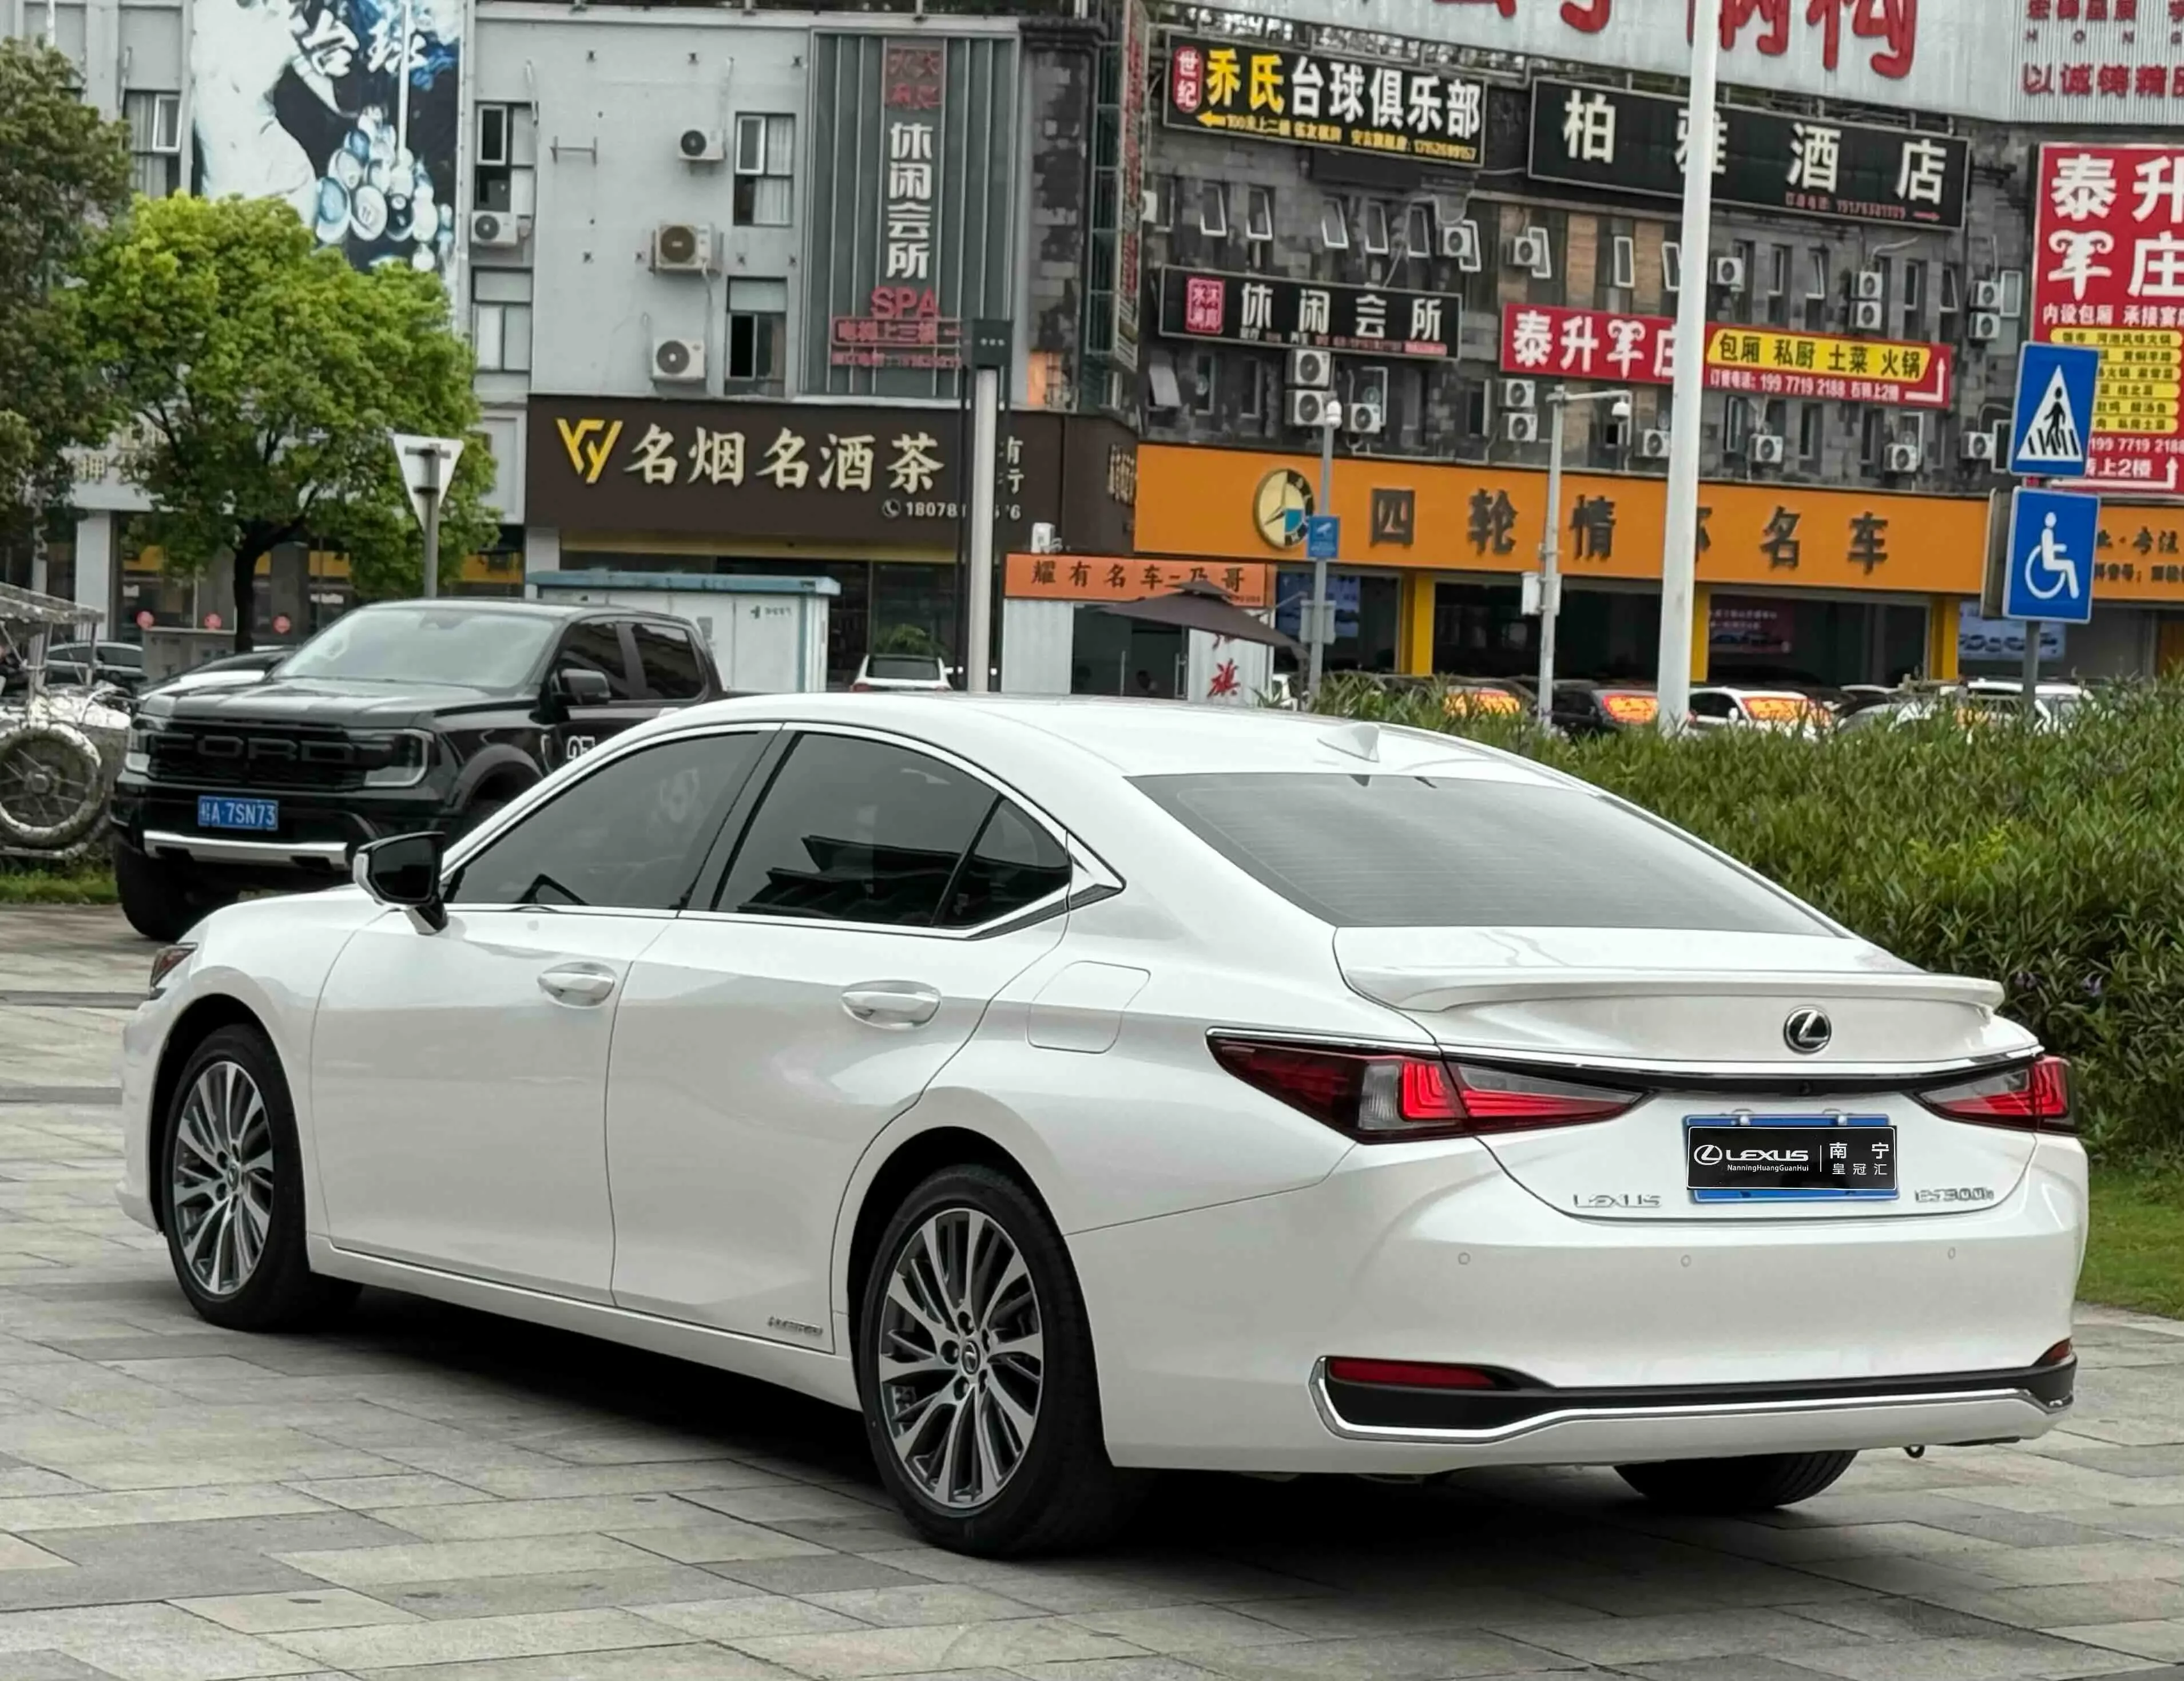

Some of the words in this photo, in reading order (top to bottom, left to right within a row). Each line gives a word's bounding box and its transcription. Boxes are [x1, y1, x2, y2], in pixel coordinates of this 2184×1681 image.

[1176, 50, 1199, 108] 世纪
[1206, 48, 1481, 140] 乔氏台球俱乐部
[886, 121, 934, 280] 休闲会所
[870, 286, 941, 320] SPA
[1241, 282, 1443, 342] 休闲会所
[1719, 332, 1761, 363] 包厢
[1774, 339, 1816, 370] 私厨
[1828, 344, 1868, 374] 土菜
[1881, 348, 1921, 378] 火锅
[624, 422, 946, 494] 名烟名酒茶
[150, 733, 354, 764] FORD
